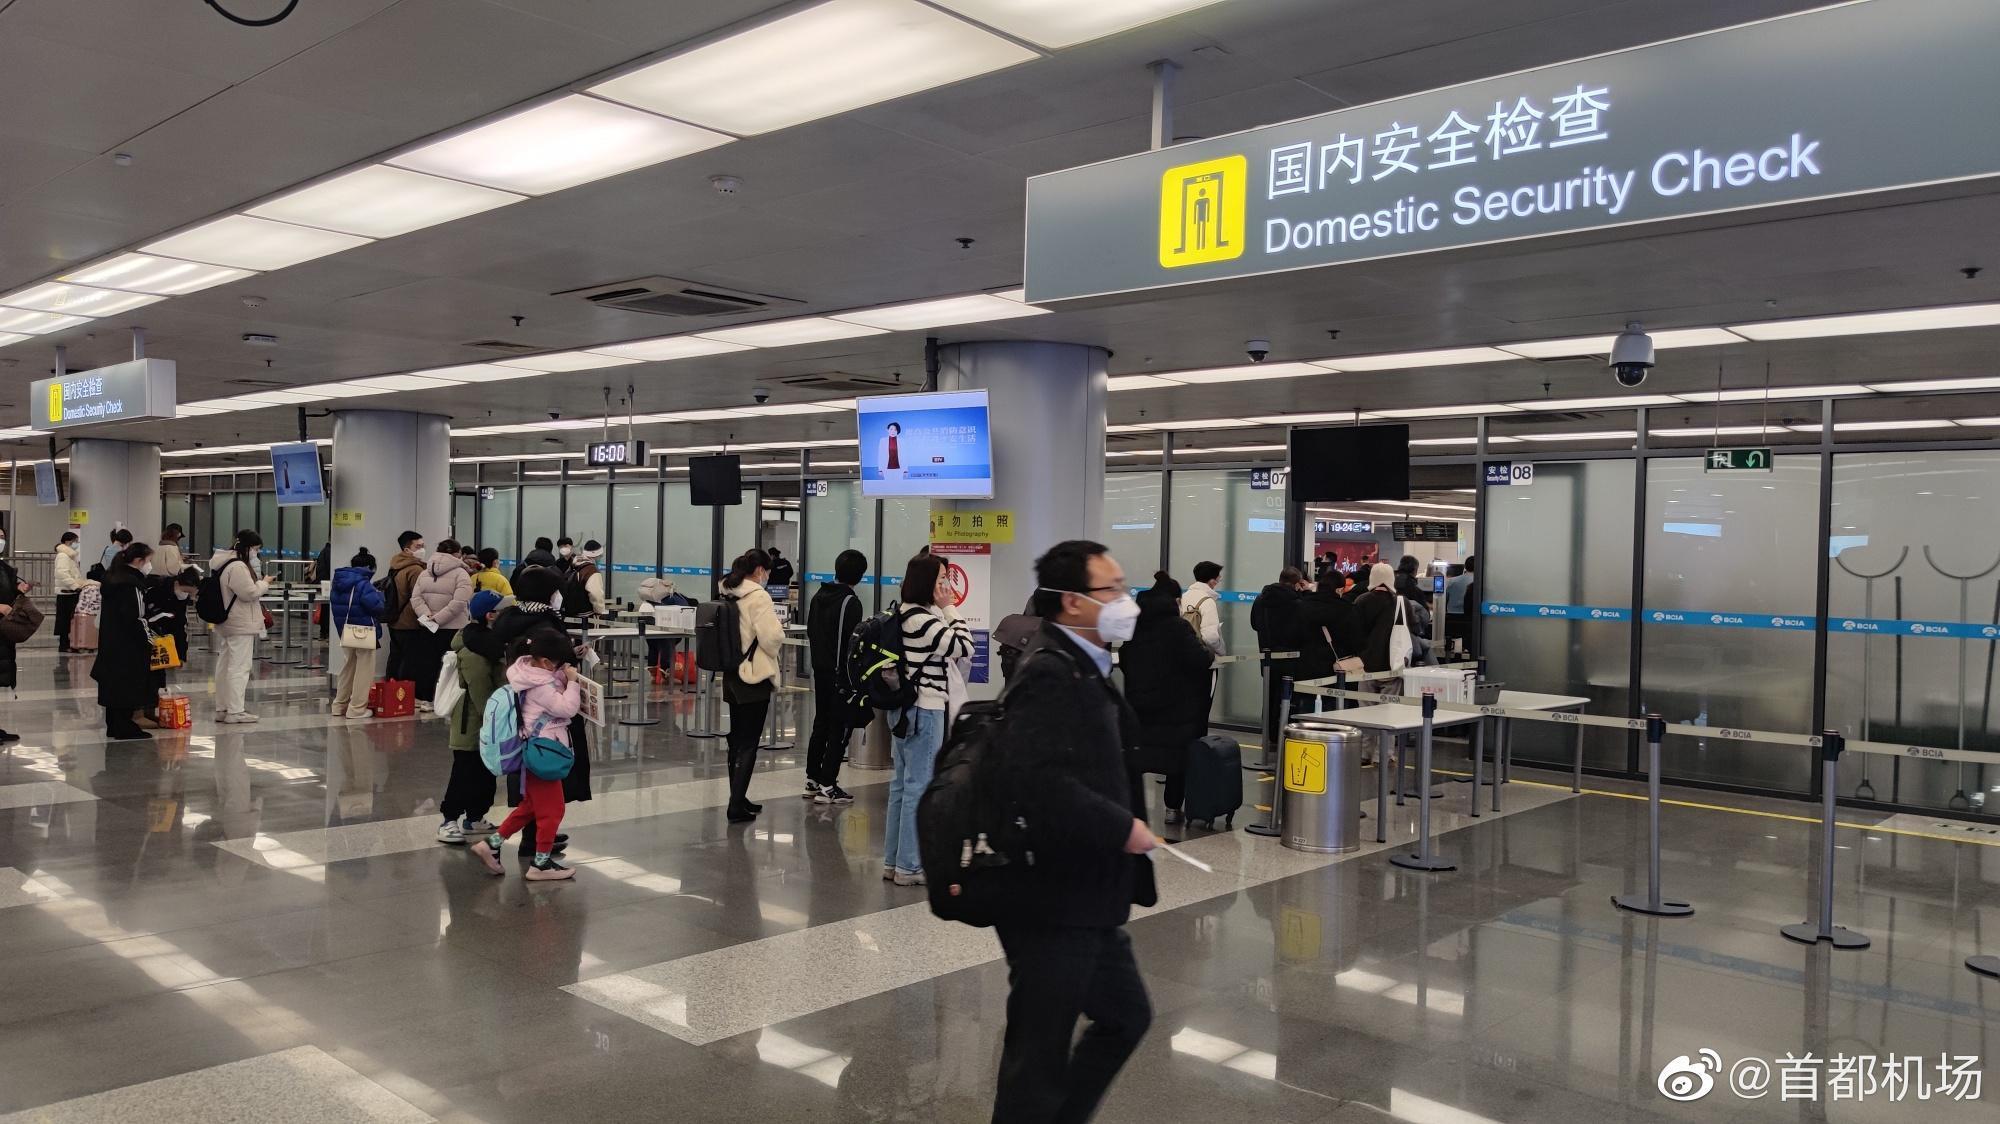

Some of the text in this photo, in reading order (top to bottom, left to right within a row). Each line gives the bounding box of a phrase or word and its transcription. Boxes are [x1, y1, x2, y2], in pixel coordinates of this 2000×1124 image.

[1267, 85, 1611, 200] 国内安全检查
[1265, 133, 1822, 254] Domestic Security Check
[64, 377, 103, 401] 国内安全检查
[64, 400, 123, 420] Domestic Security Check
[594, 444, 625, 462] 16:00
[1488, 465, 1508, 475] 安检
[1512, 466, 1531, 480] 08
[1252, 472, 1269, 480] 安检
[1271, 472, 1286, 485] 07
[817, 483, 827, 493] 06
[937, 514, 1009, 528] 请勿拍照
[1723, 616, 1743, 624] BCIA
[1785, 619, 1805, 627] BCIA
[1490, 707, 1506, 715] BCIA
[1562, 714, 1579, 722] BCIA
[1732, 731, 1752, 739] BCIA
[1922, 748, 1944, 758] BCIA
